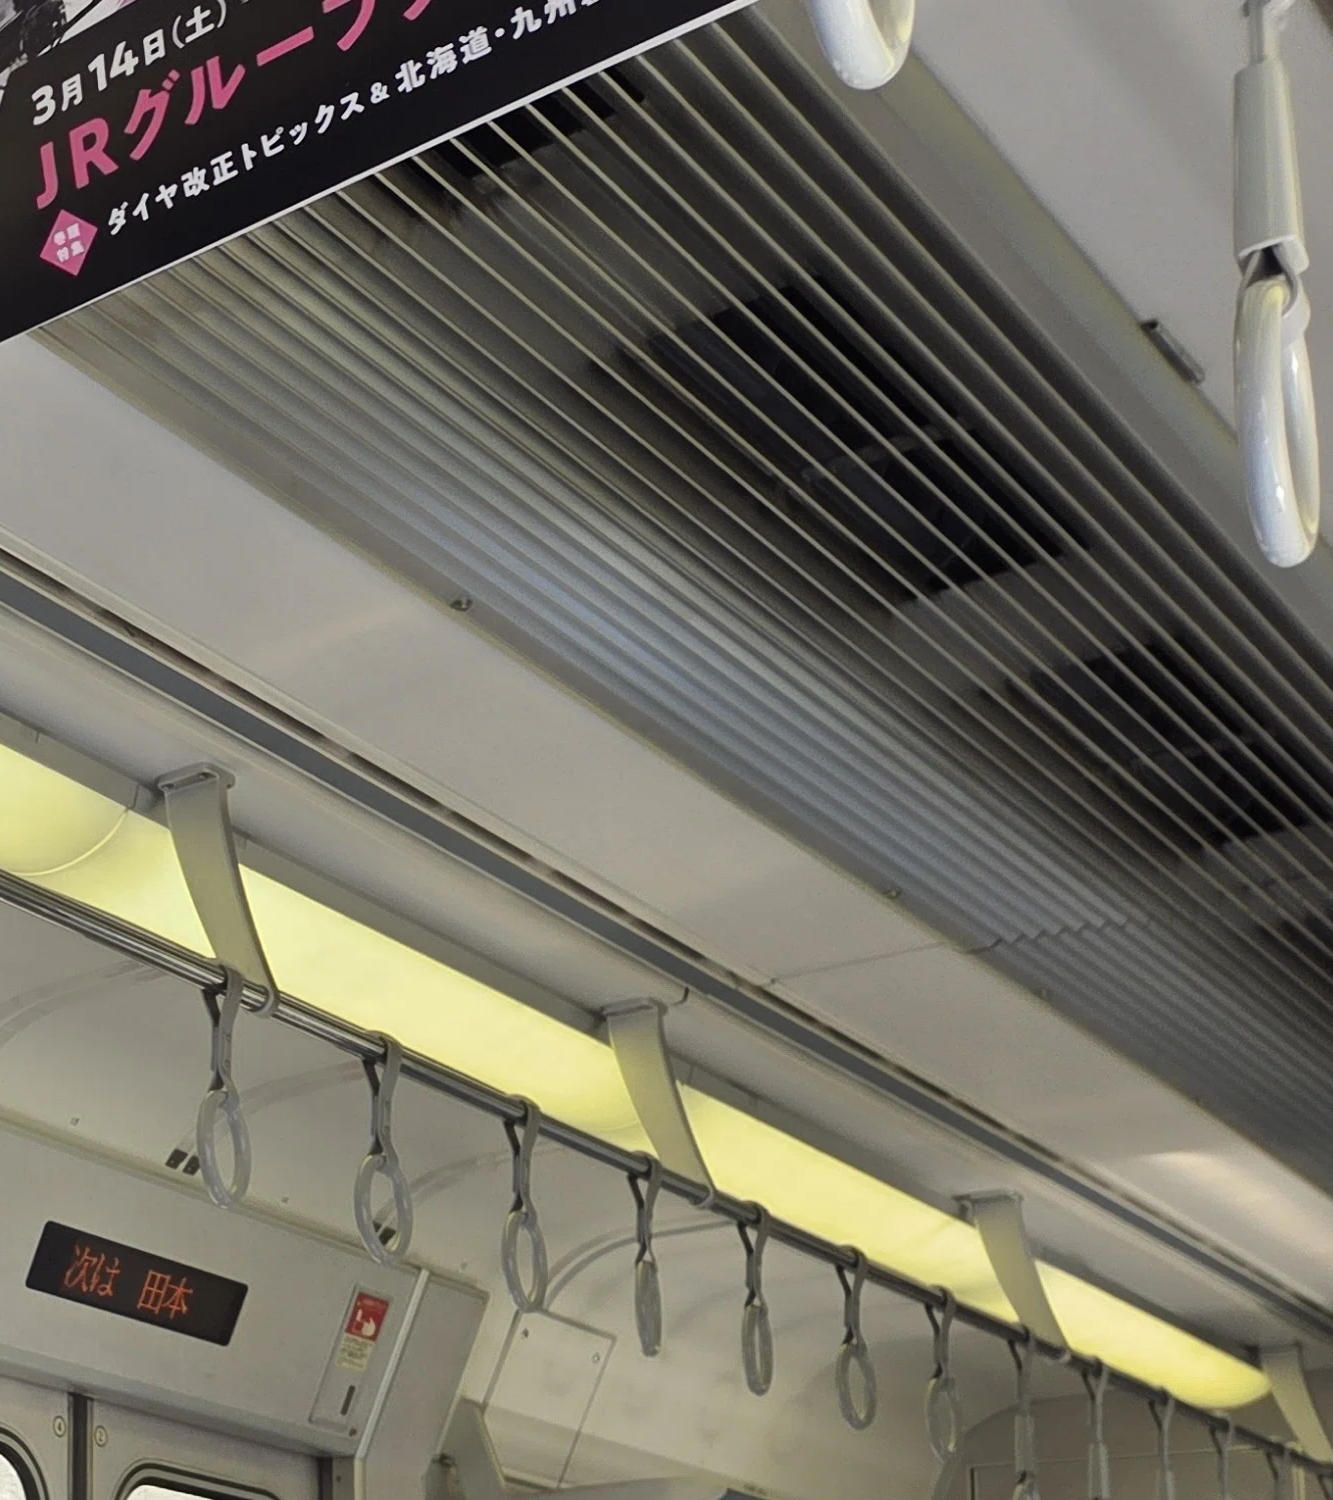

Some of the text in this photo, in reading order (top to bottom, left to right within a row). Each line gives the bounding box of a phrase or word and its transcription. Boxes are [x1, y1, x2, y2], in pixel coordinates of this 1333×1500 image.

[36, 0, 431, 209] JRグルー
[63, 1242, 194, 1320] 次は 田本
